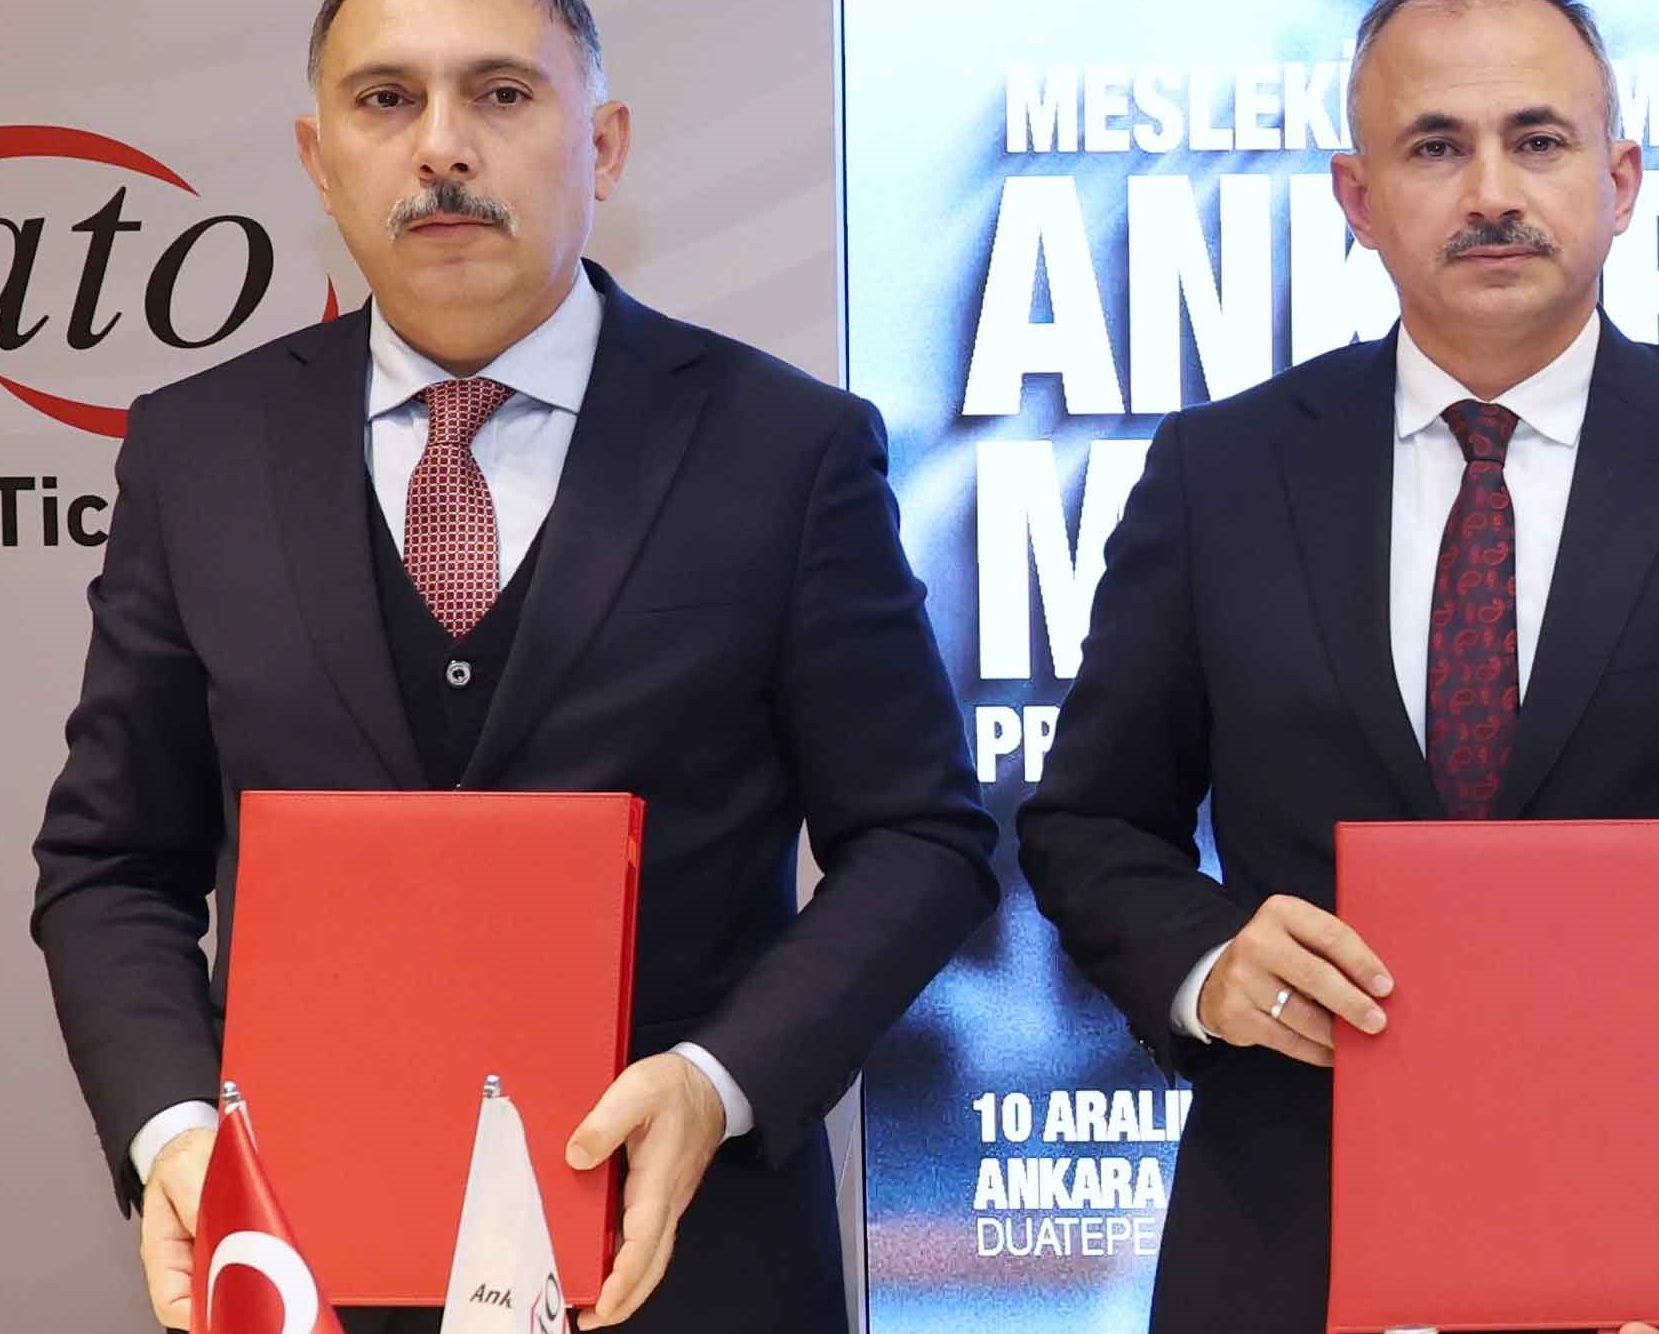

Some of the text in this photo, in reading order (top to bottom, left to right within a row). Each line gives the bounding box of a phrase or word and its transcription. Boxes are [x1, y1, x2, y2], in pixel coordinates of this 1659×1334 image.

[973, 1092, 1033, 1143] 10
[973, 1157, 1168, 1210] ANKARA
[976, 1216, 1159, 1257] DUATEPE
